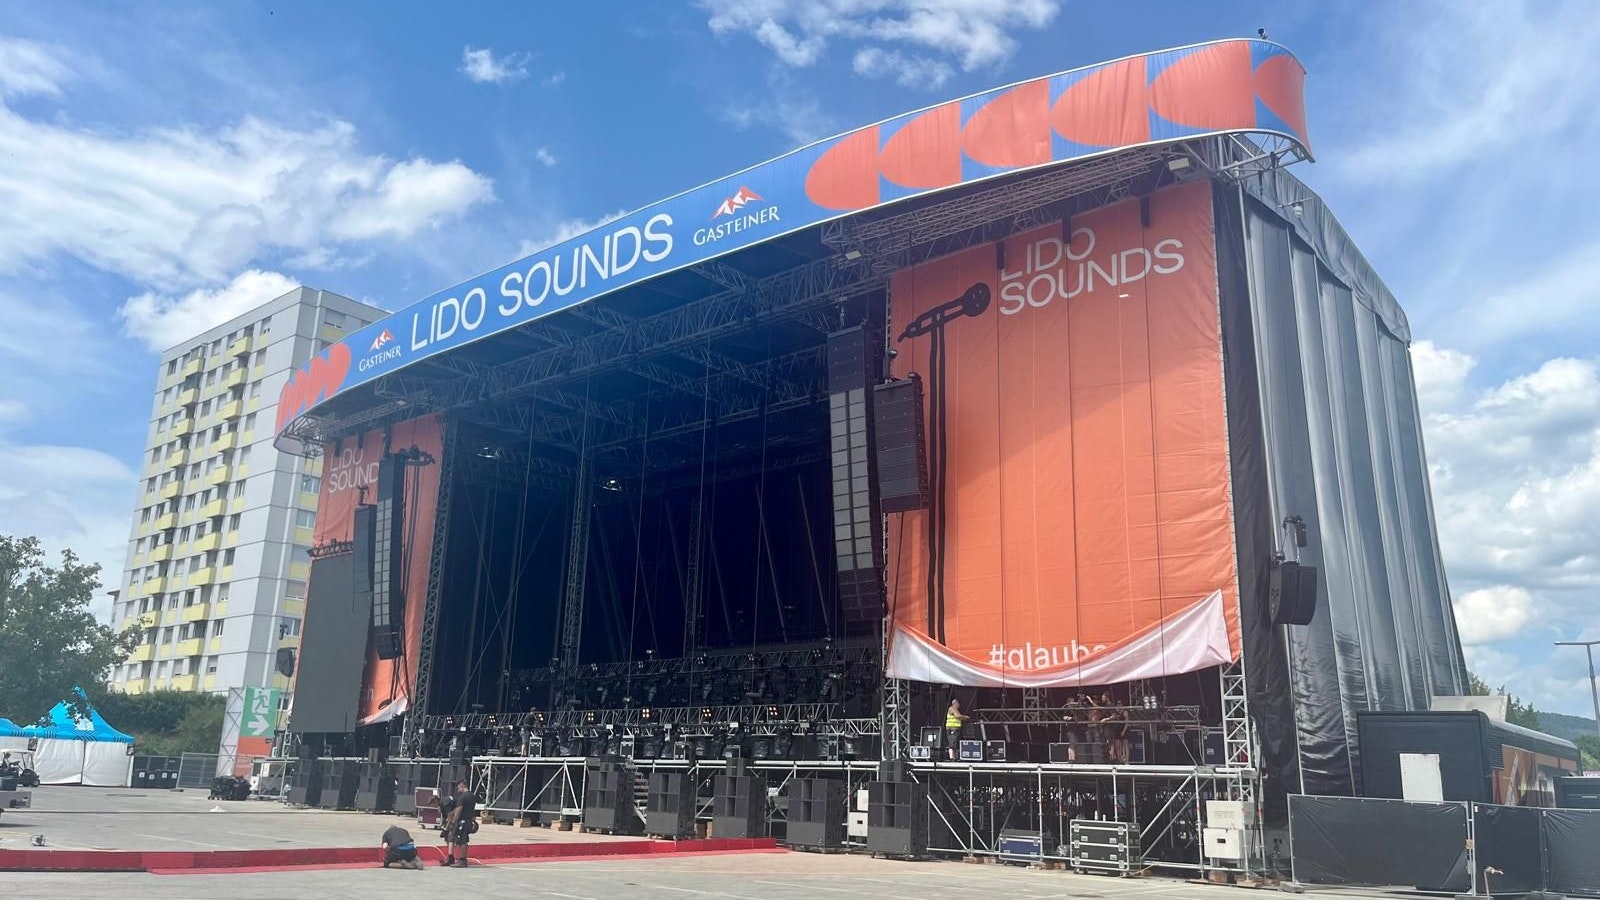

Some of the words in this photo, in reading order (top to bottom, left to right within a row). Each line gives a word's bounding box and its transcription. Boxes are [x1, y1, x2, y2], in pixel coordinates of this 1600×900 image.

[693, 206, 780, 246] GASTEINER
[999, 238, 1185, 316] SOUNDS
[1001, 227, 1096, 281] LIDO
[410, 287, 486, 352] LIDO
[498, 213, 674, 316] SOUNDS
[358, 344, 402, 372] GASTEINER
[328, 462, 379, 493] SOUND
